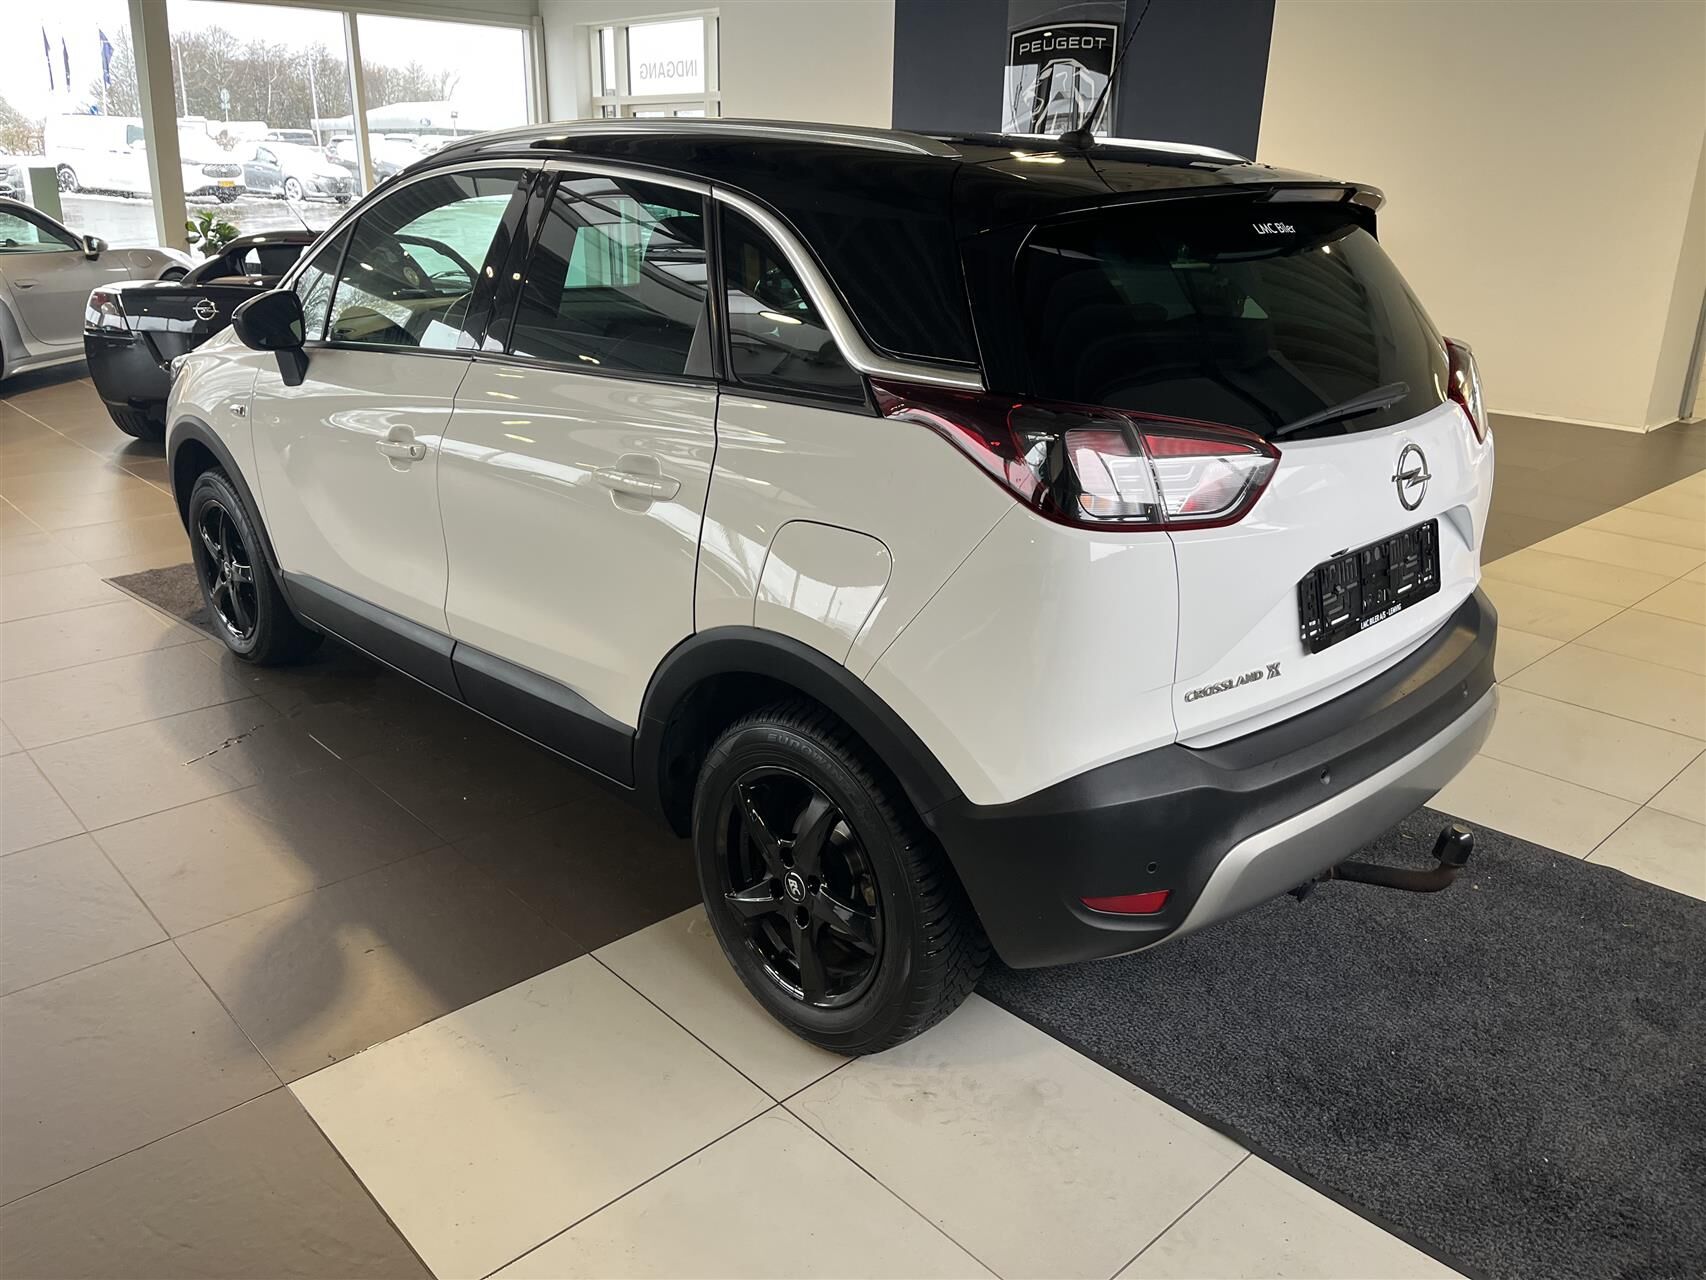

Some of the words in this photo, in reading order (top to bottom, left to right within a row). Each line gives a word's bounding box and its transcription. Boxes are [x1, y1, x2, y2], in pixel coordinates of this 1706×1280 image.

[1019, 36, 1107, 56] PEUGEOT
[1252, 222, 1278, 235] LMC
[1274, 222, 1296, 234] Biler
[1184, 670, 1264, 703] CROSSLAND
[1266, 662, 1282, 680] X
